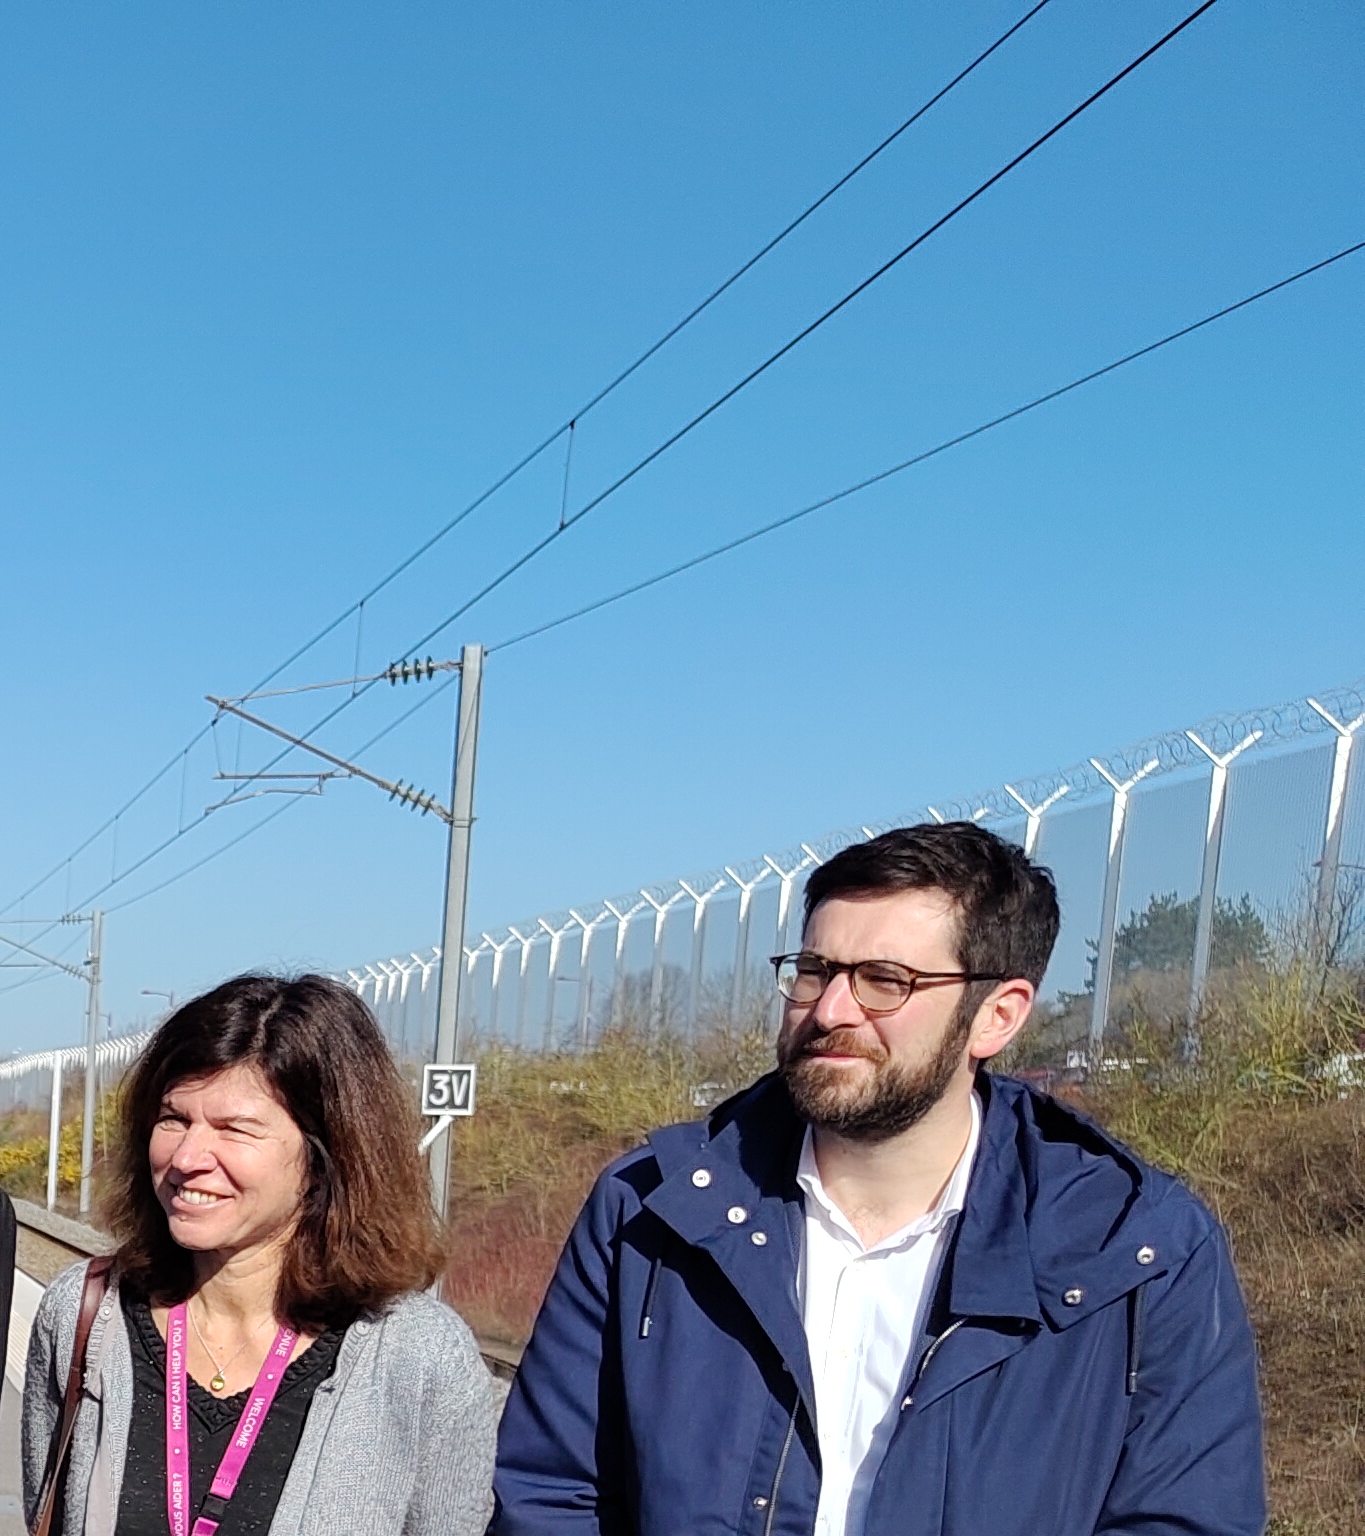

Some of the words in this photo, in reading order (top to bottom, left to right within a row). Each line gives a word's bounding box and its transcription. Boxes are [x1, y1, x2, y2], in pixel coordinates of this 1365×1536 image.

[429, 1073, 469, 1106] 3V
[173, 1327, 182, 1349] YOU
[172, 1350, 181, 1374] HELP
[171, 1381, 181, 1403] CAN
[172, 1405, 182, 1430] HOW
[236, 1398, 266, 1449] WELCOME
[172, 1480, 183, 1510] AIDER
